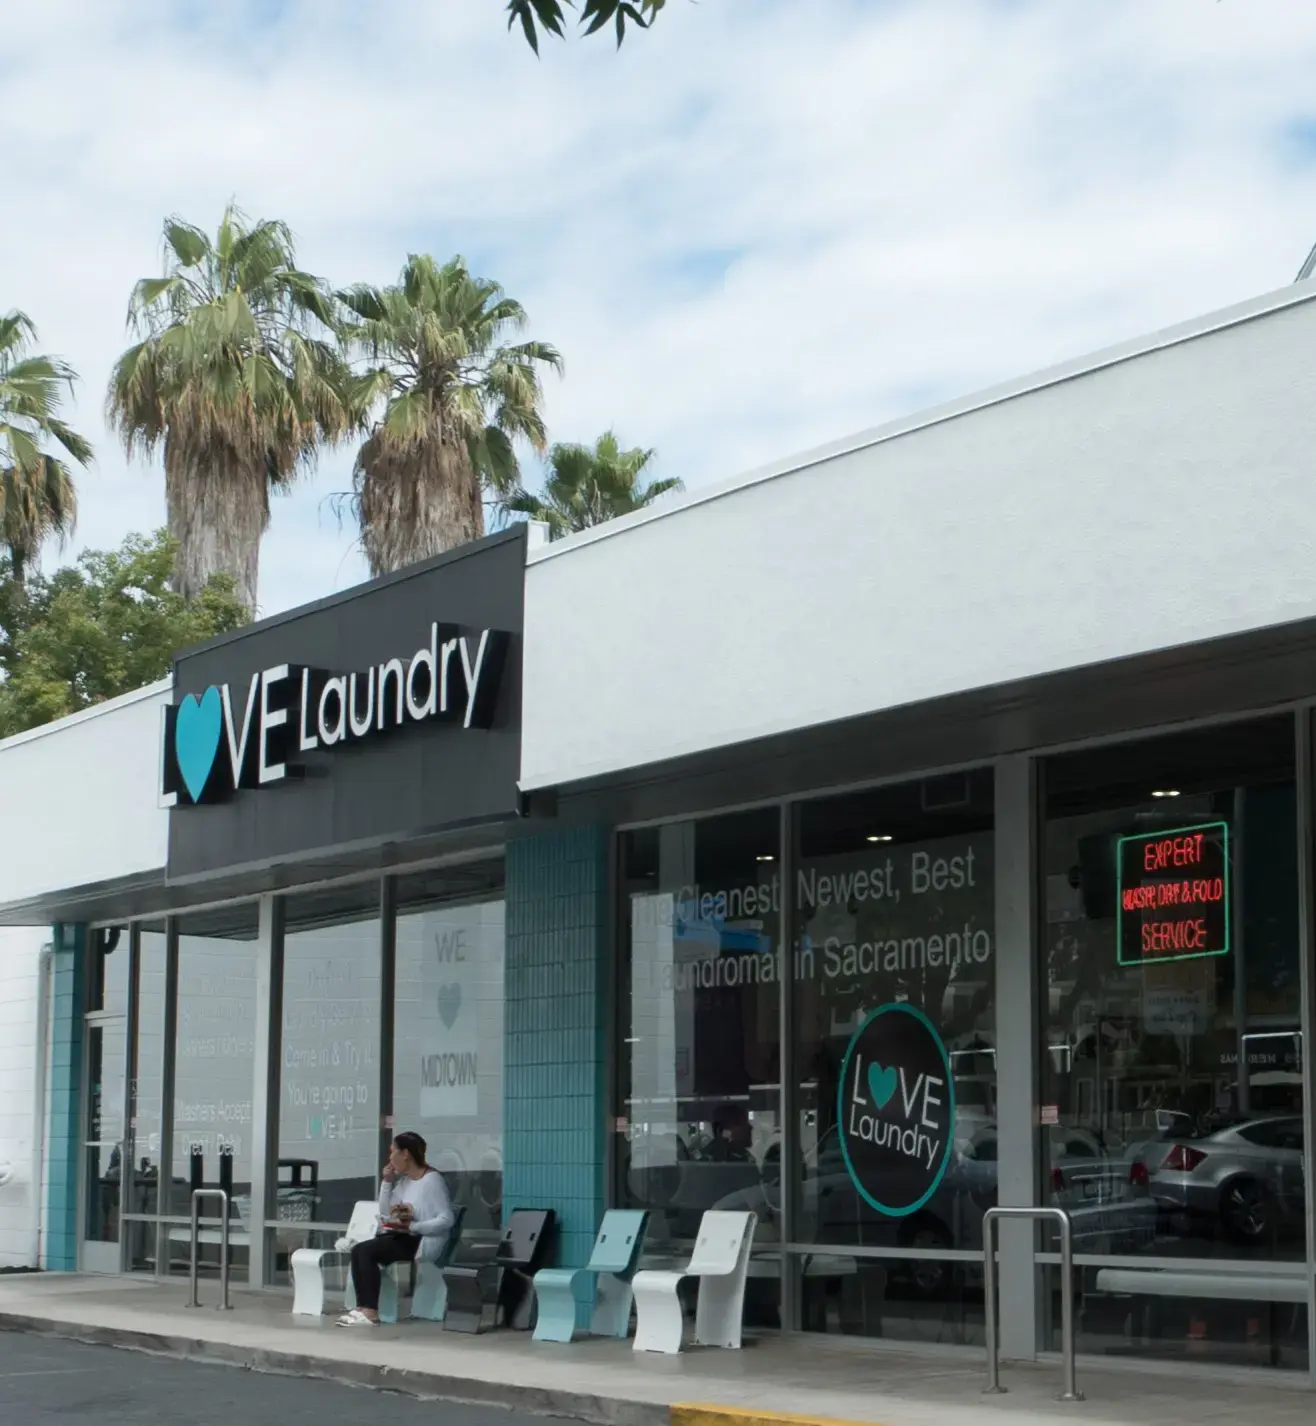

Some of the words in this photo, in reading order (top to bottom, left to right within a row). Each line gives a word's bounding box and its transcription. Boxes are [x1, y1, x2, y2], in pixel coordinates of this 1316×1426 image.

[300, 622, 491, 751] Laundry
[1144, 833, 1205, 871] EXPERT
[797, 858, 901, 910] Newest,
[911, 845, 976, 894] Best
[1193, 878, 1223, 903] FOLD
[434, 929, 467, 963] WE
[1141, 918, 1208, 952] SERVICE
[651, 943, 783, 991] aundromat
[793, 941, 815, 980] in
[823, 922, 991, 979] Sacramento
[421, 1052, 477, 1088] MIDTOWN
[849, 1102, 940, 1171] Laundry
